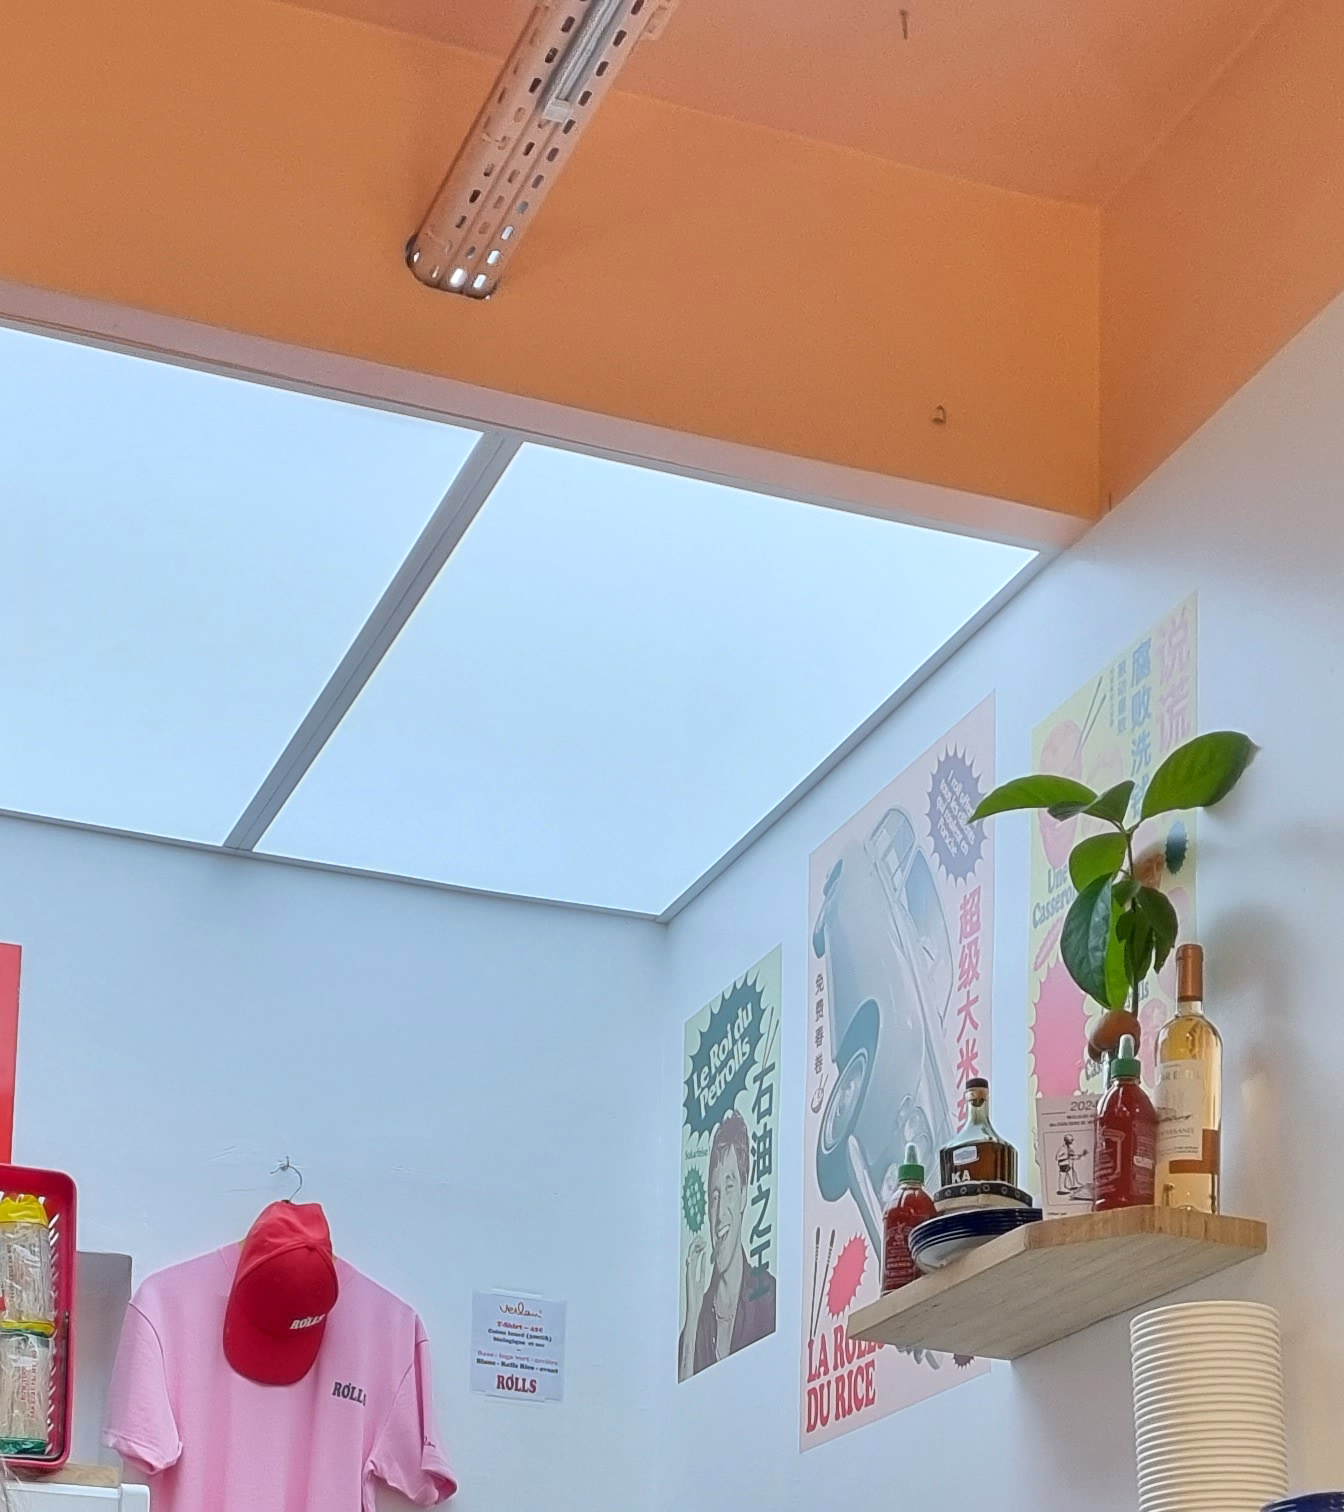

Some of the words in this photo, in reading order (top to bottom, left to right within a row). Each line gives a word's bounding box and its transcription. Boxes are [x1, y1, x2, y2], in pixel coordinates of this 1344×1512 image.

[694, 1064, 710, 1097] Le
[709, 1030, 734, 1074] Roi
[734, 1002, 753, 1037] du
[699, 1034, 751, 1119] Petrolls
[806, 1379, 831, 1433] DU
[834, 1359, 876, 1421] RICE
[807, 1333, 829, 1383] LA
